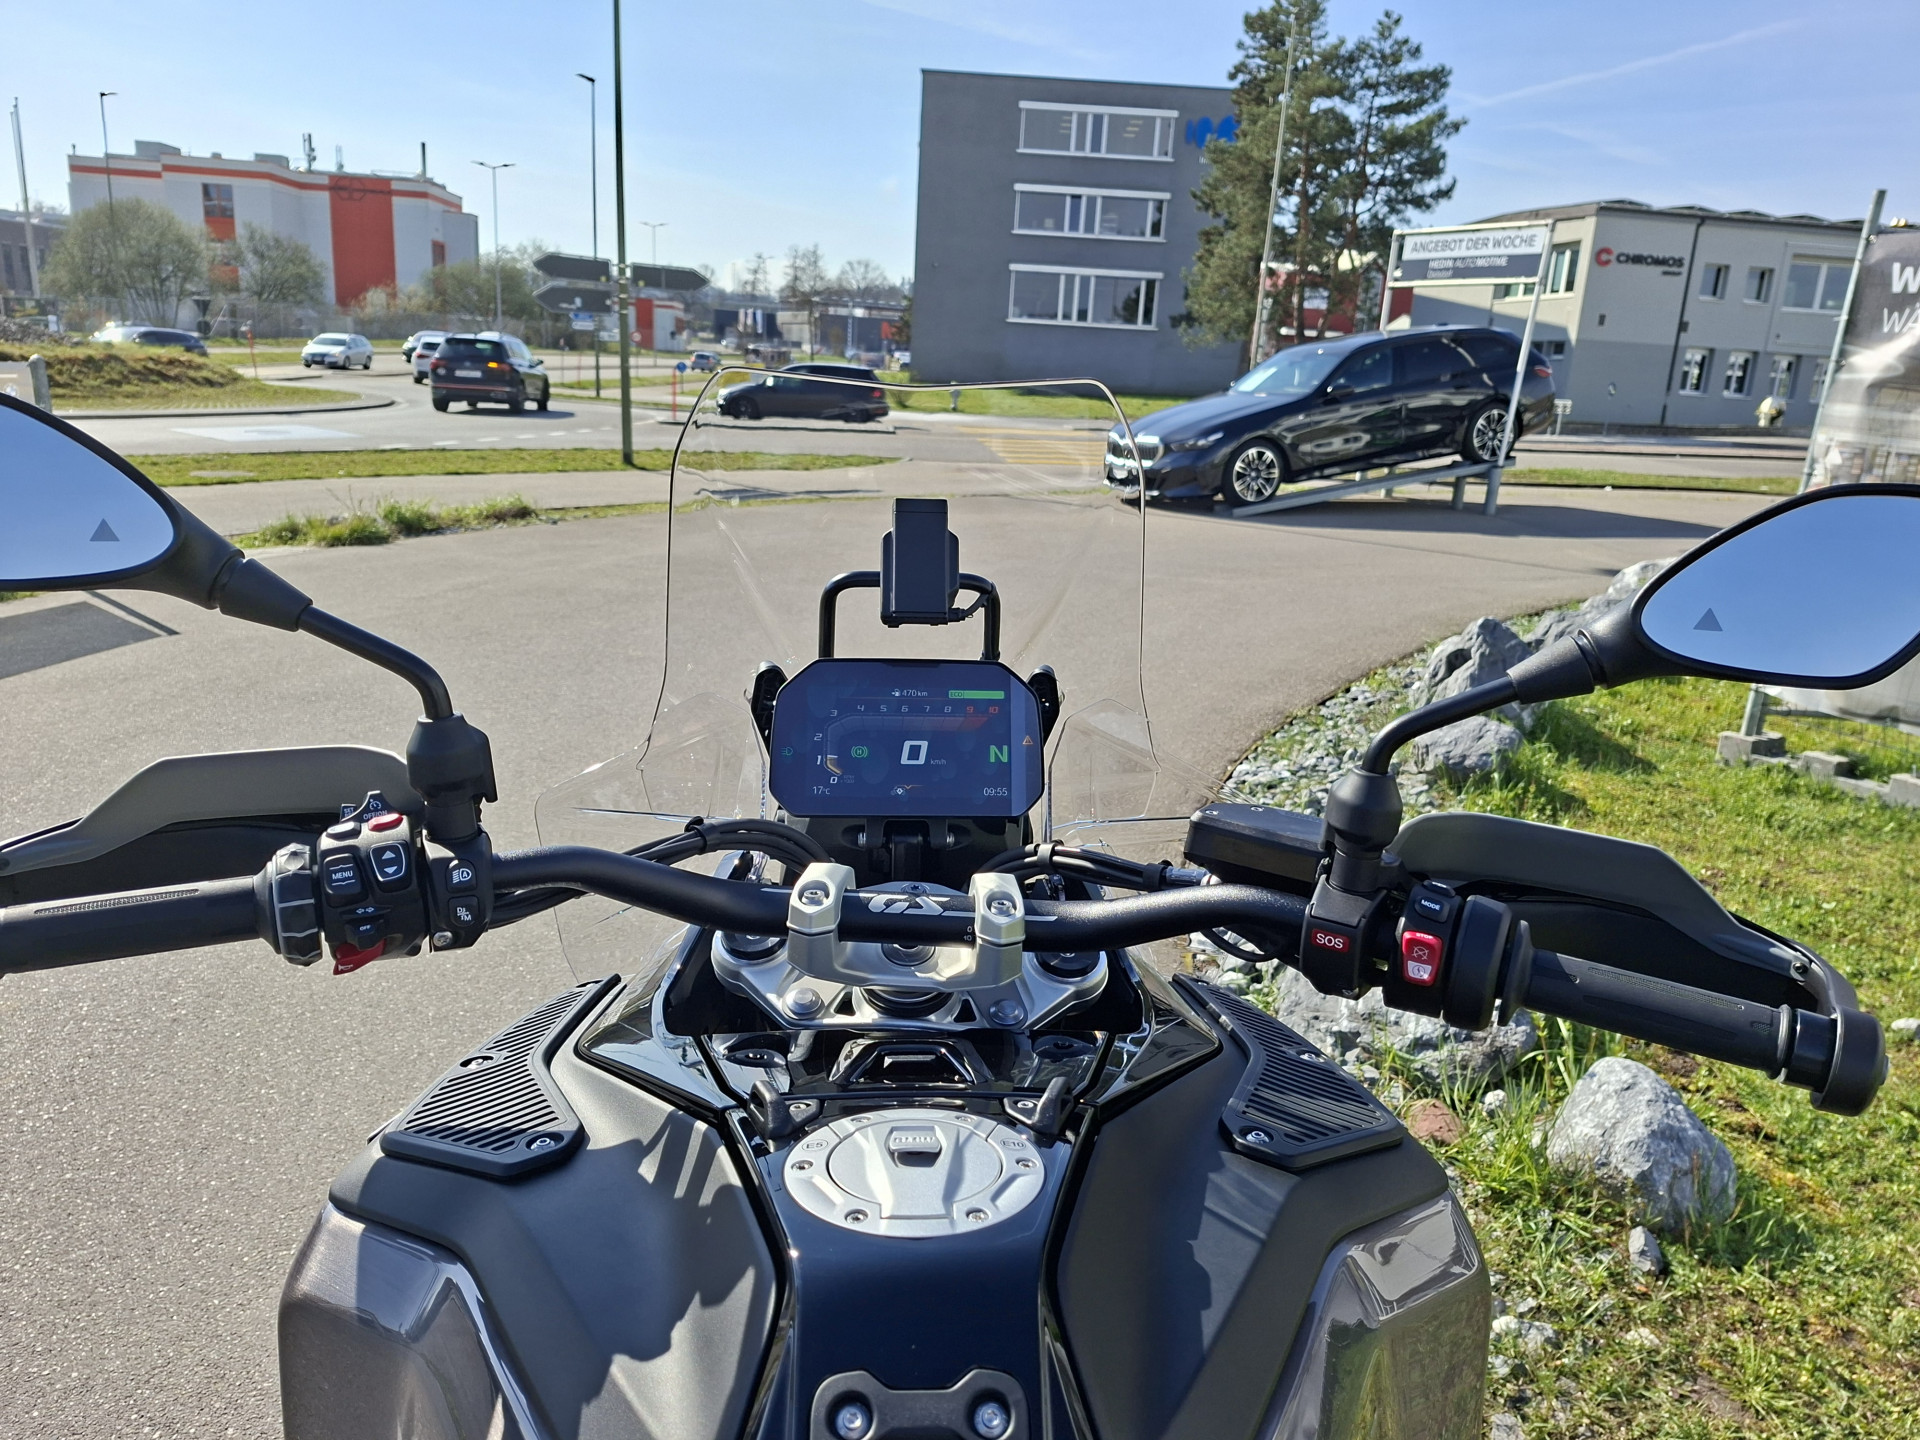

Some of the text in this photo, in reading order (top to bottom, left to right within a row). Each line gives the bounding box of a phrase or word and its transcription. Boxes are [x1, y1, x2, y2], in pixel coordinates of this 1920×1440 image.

[1411, 234, 1538, 253] ANGEBOT DER WOCHE
[1616, 252, 1685, 268] CHROMOS
[902, 689, 917, 697] 470
[830, 709, 838, 717] 3
[813, 733, 823, 741] 2
[900, 740, 947, 766] 0 km/h
[989, 745, 1008, 763] N
[816, 755, 822, 765] 1
[830, 776, 838, 784] 0
[983, 788, 1008, 796] 09:55
[332, 870, 354, 880] MENU
[1421, 899, 1440, 911] MODE
[966, 925, 973, 933] 0
[963, 934, 972, 942] 10
[1316, 933, 1344, 949] SOS
[805, 1141, 824, 1149] E5
[1002, 1140, 1025, 1148] E10
